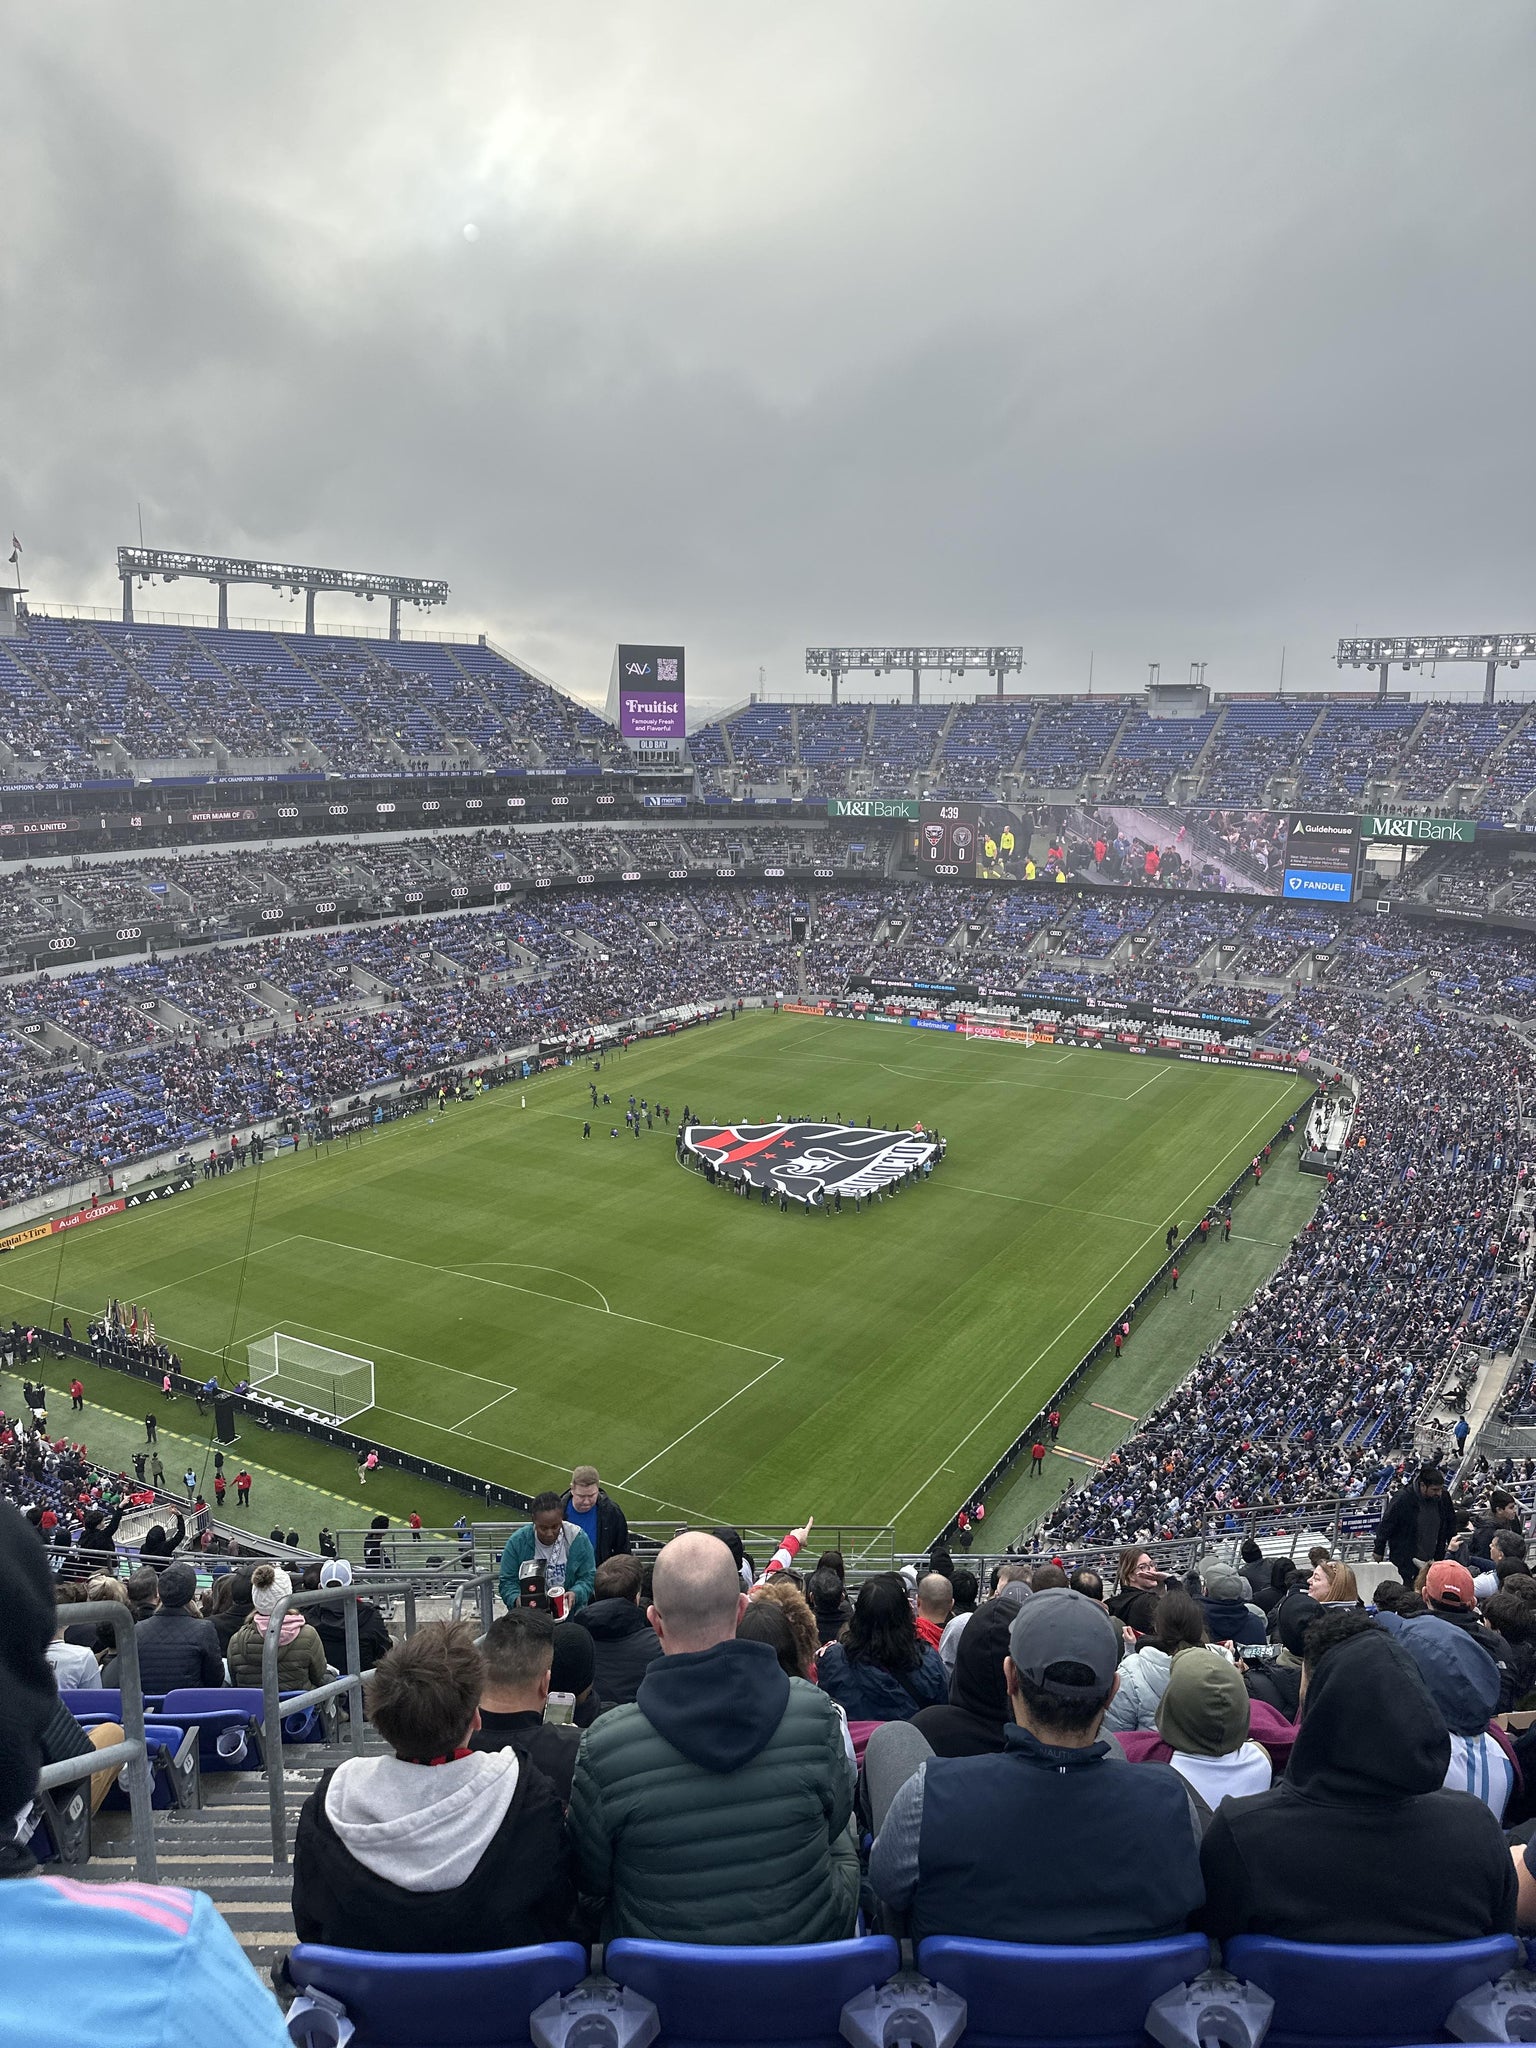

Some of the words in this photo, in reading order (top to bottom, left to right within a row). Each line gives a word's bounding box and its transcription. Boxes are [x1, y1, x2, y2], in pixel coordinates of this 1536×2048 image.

[625, 699, 679, 714] Fruitist
[641, 741, 654, 749] OLD
[654, 741, 667, 749] BAY
[2, 784, 35, 792] CHAMPIONS
[836, 800, 873, 816] M&T
[874, 802, 910, 817] Bank
[940, 806, 959, 819] 4:39
[40, 823, 68, 831] UNITED
[1305, 825, 1353, 835] Guidehouse
[1371, 817, 1418, 838] M&T
[1418, 820, 1463, 841] Bank
[930, 846, 937, 859] 0
[958, 848, 965, 860] 0
[1303, 881, 1346, 892] FANDUEL
[871, 978, 887, 986] Better
[887, 980, 914, 988] questions.
[914, 982, 931, 990] Better
[1152, 1006, 1171, 1015] Better
[1170, 1010, 1201, 1019] questions.
[1201, 1012, 1221, 1021] Better
[1220, 1016, 1252, 1026] outcomes.
[916, 1020, 950, 1031] ticketmaster
[1179, 1053, 1200, 1061] SCORE
[1200, 1055, 1220, 1065] BIG
[1236, 1061, 1284, 1071] STEAMFITTERS
[58, 1215, 80, 1229] Audi
[28, 1227, 47, 1239] Tire
[72, 1801, 81, 1815] 16
